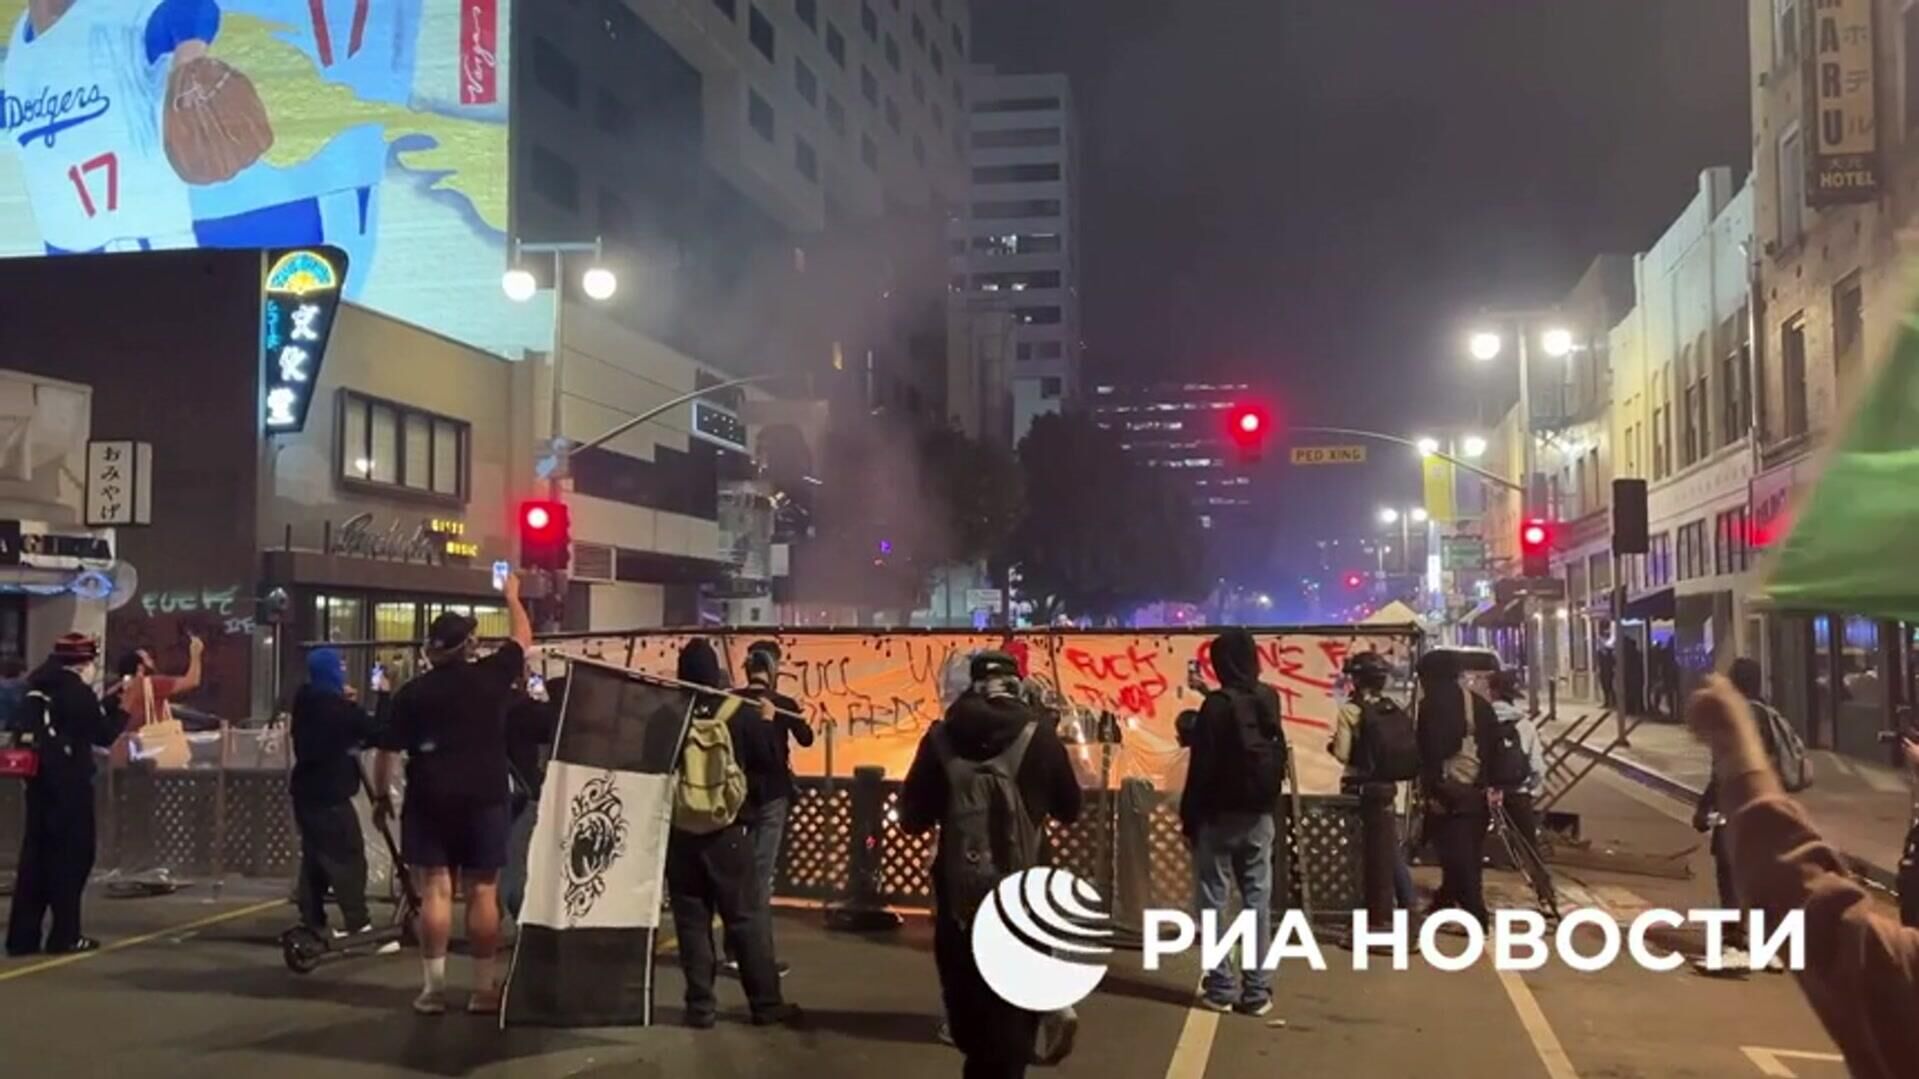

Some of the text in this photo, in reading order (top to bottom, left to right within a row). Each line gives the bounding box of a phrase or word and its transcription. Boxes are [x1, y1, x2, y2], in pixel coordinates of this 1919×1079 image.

[4, 84, 110, 148] Dodgers
[68, 152, 118, 218] 17
[1820, 171, 1876, 188] HOTEL
[266, 304, 321, 425] 文化堂
[101, 446, 122, 520] おみやげ
[1295, 448, 1362, 462] PED XING
[1065, 645, 1158, 682] FUCK
